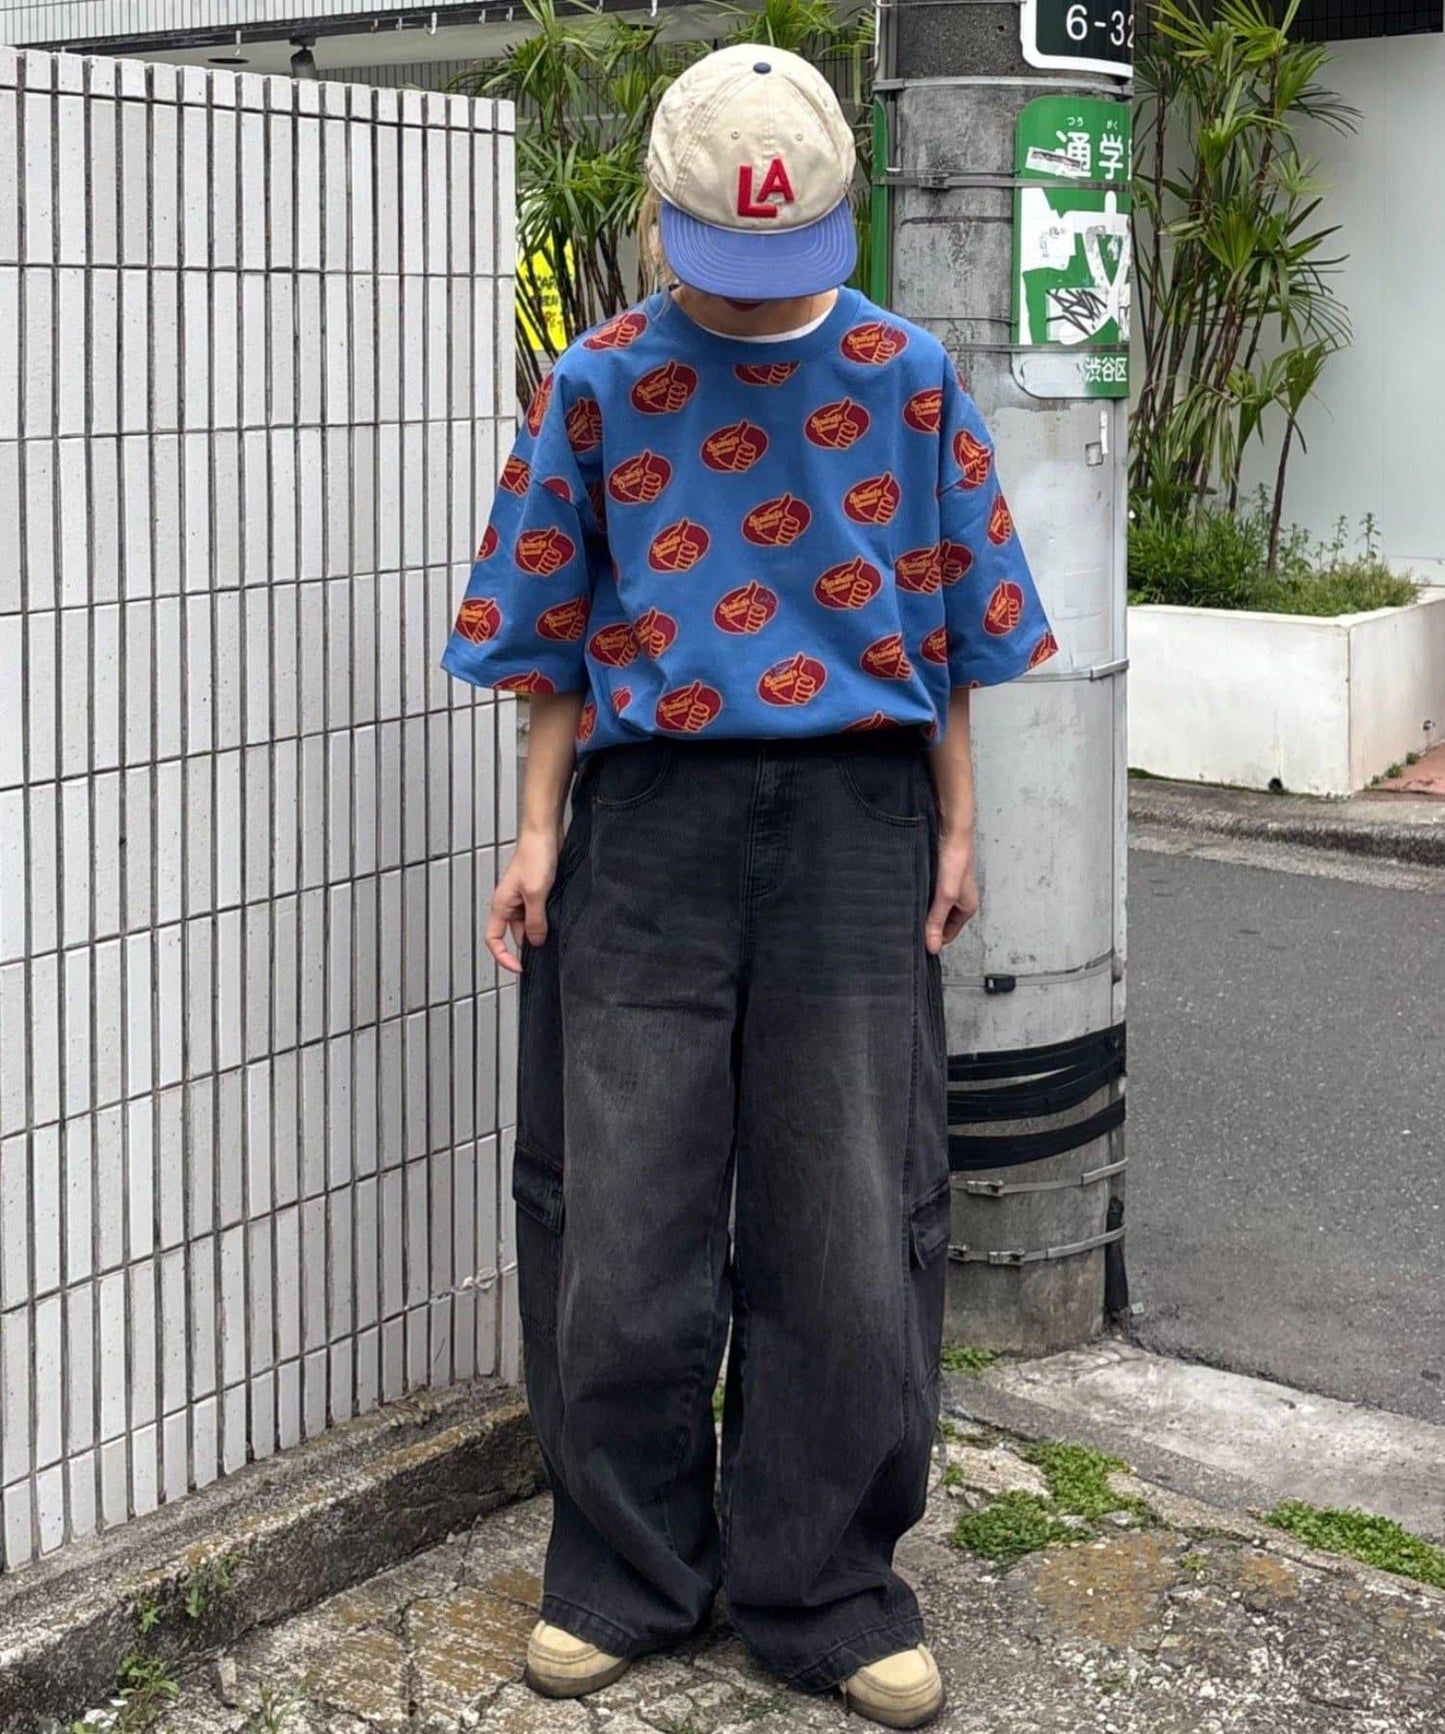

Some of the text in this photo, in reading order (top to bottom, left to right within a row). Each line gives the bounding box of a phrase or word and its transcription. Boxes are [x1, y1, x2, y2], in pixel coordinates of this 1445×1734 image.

[1056, 130, 1132, 181] 通学
[737, 157, 795, 218] LA
[1084, 356, 1128, 382] 渋谷区
